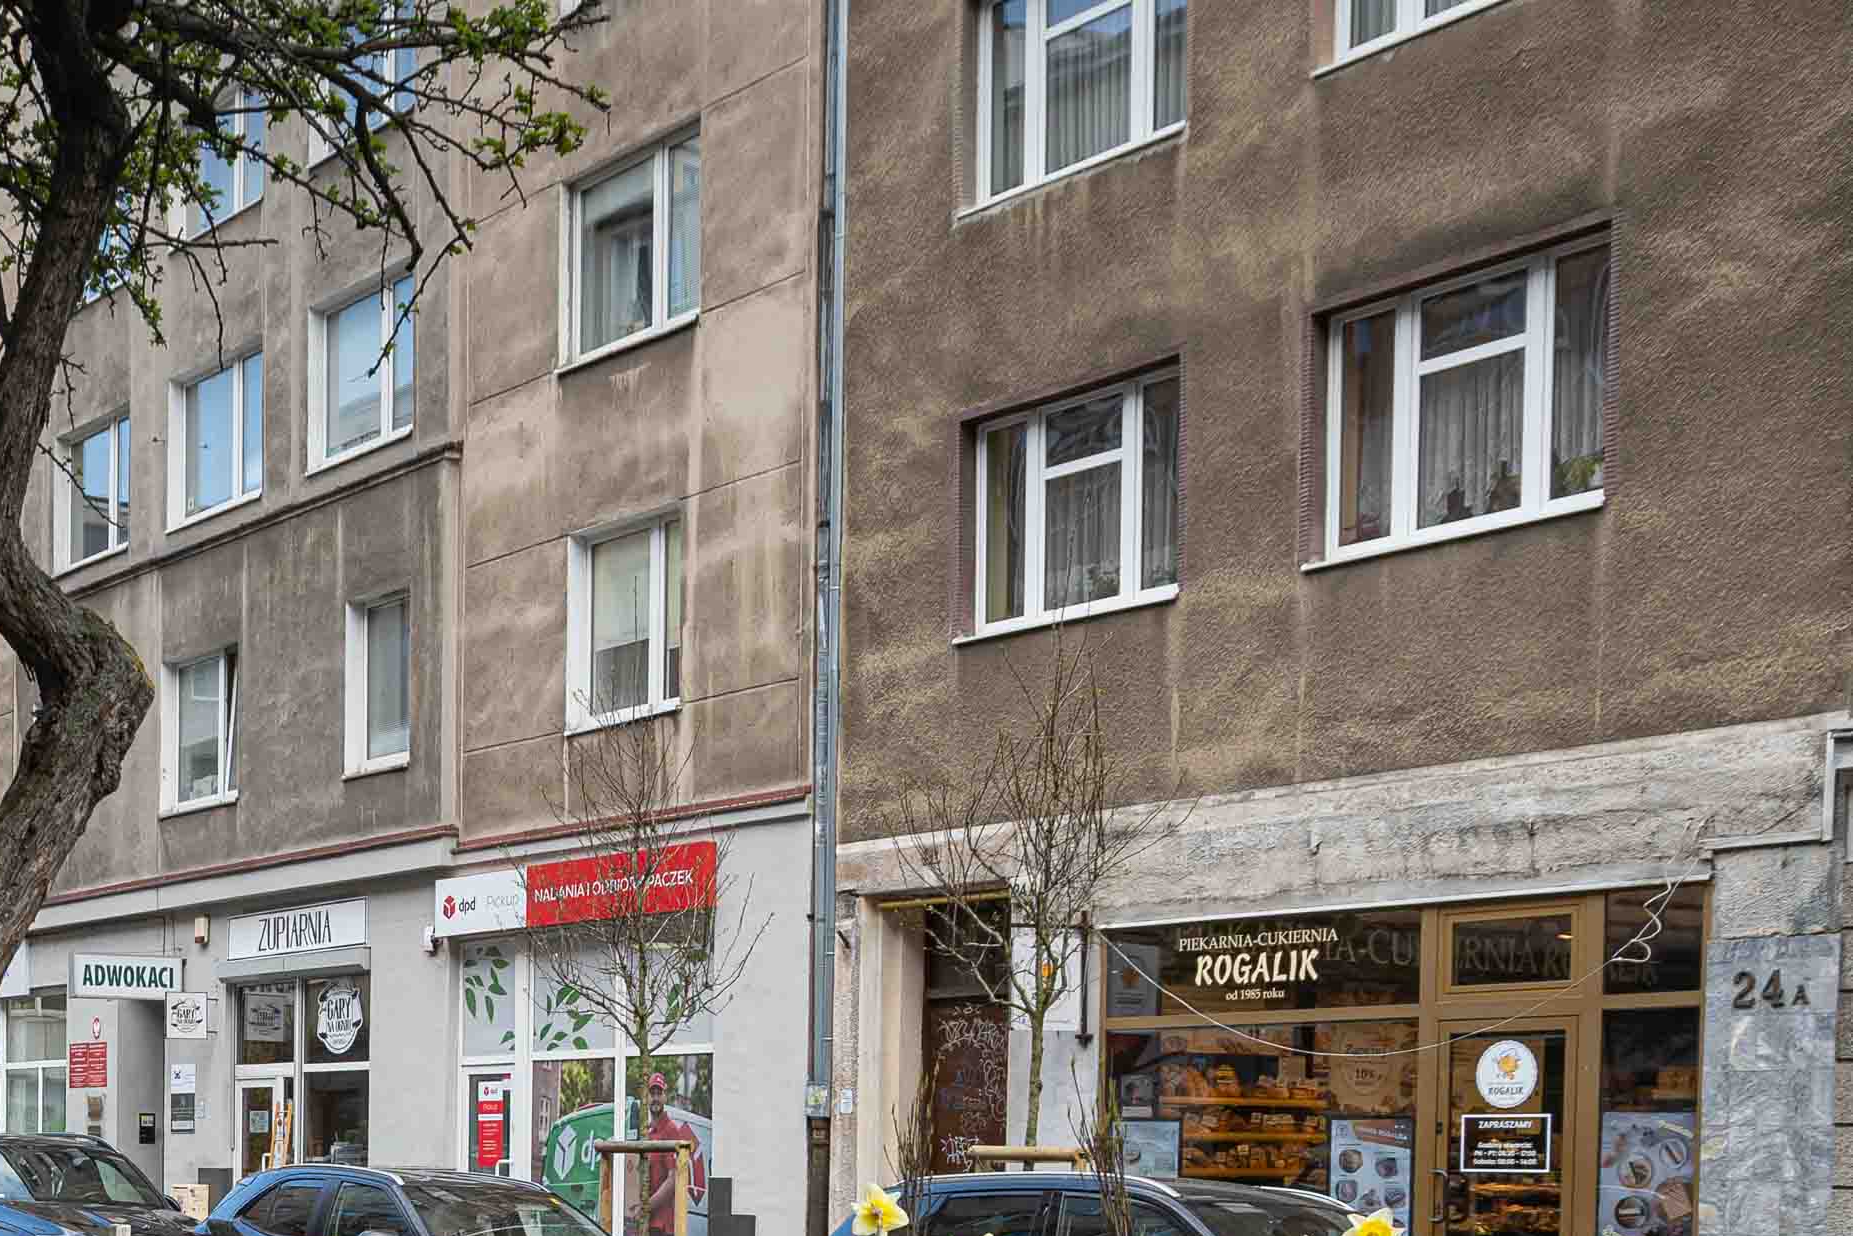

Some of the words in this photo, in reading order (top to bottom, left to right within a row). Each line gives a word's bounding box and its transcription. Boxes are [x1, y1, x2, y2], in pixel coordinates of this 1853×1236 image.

[648, 869, 693, 889] PACZEK
[458, 896, 476, 915] dpd
[258, 909, 332, 952] ZUPIARNIA
[1178, 927, 1339, 952] PIEKARNIA-CUKIERNIA
[83, 963, 174, 990] ADWOKACI
[1195, 948, 1319, 987] ROGALIK
[1226, 990, 1238, 1000] od
[1263, 988, 1285, 999] roku
[327, 997, 351, 1020] GARY
